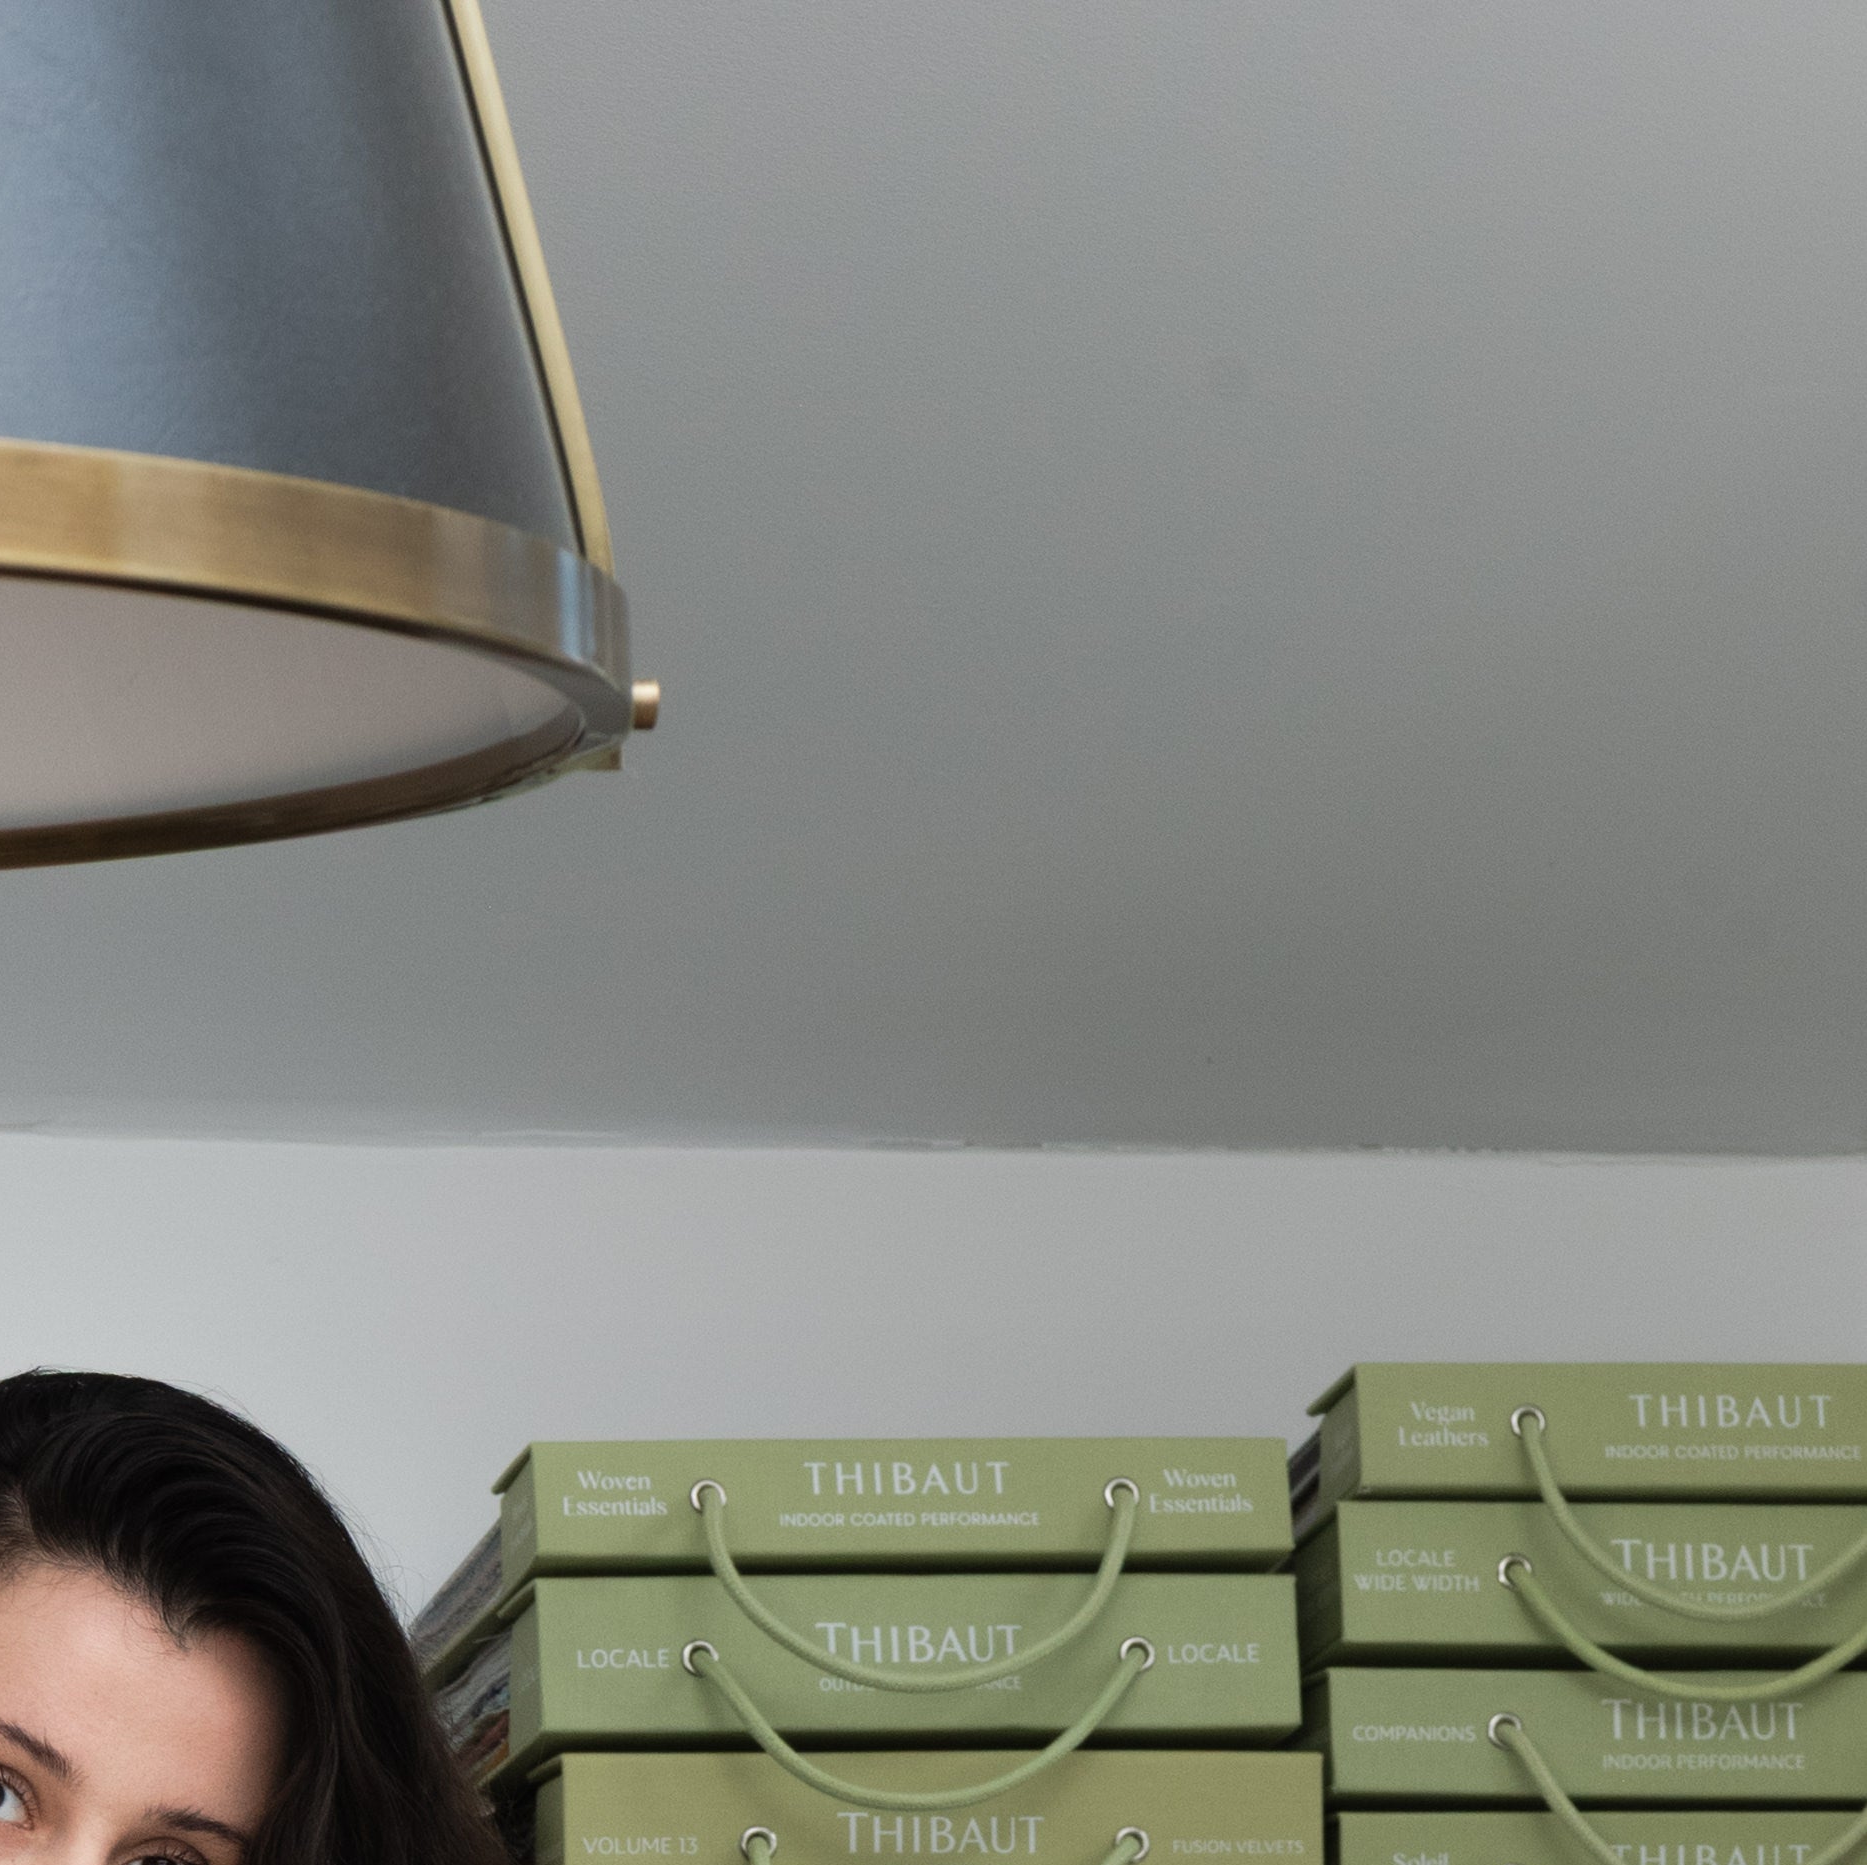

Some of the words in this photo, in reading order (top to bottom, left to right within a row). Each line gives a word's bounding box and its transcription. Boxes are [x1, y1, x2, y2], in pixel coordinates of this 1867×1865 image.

[1409, 1400, 1476, 1427] Vegan
[1628, 1394, 1831, 1429] THIBAUT
[1398, 1422, 1490, 1448] Leathers
[1604, 1444, 1670, 1460] INDOOR
[1673, 1443, 1740, 1461] COATED
[1743, 1444, 1862, 1461] PERFORMANCE
[576, 1470, 652, 1491] Woven
[803, 1461, 1009, 1496] THIBAUT
[1162, 1468, 1237, 1489] Woven
[563, 1495, 668, 1517] Essentials
[1149, 1492, 1254, 1514] Essentials
[779, 1512, 846, 1528] INDOOR
[849, 1511, 917, 1528] COATED
[920, 1511, 1040, 1527] PERFORMANCE
[1375, 1548, 1456, 1569] LOCALE
[1610, 1539, 1813, 1583] THIBAUT
[1353, 1573, 1407, 1592] WIDE
[1411, 1573, 1480, 1593] WIDTH
[815, 1621, 1023, 1665] THIBAUT
[1167, 1642, 1260, 1665] LOCALE
[576, 1648, 670, 1670] LOCALE
[1601, 1698, 1804, 1740] THIBAUT
[1351, 1724, 1477, 1743] COMPANIONS
[1601, 1753, 1673, 1771] INDOOR
[1676, 1753, 1806, 1771] PERFORMANCE
[837, 1811, 1045, 1855] THIBAUT
[582, 1835, 672, 1856] VOLUME
[678, 1836, 700, 1856] 13
[1172, 1838, 1232, 1855] FUSION
[1235, 1838, 1305, 1855] VELVETS
